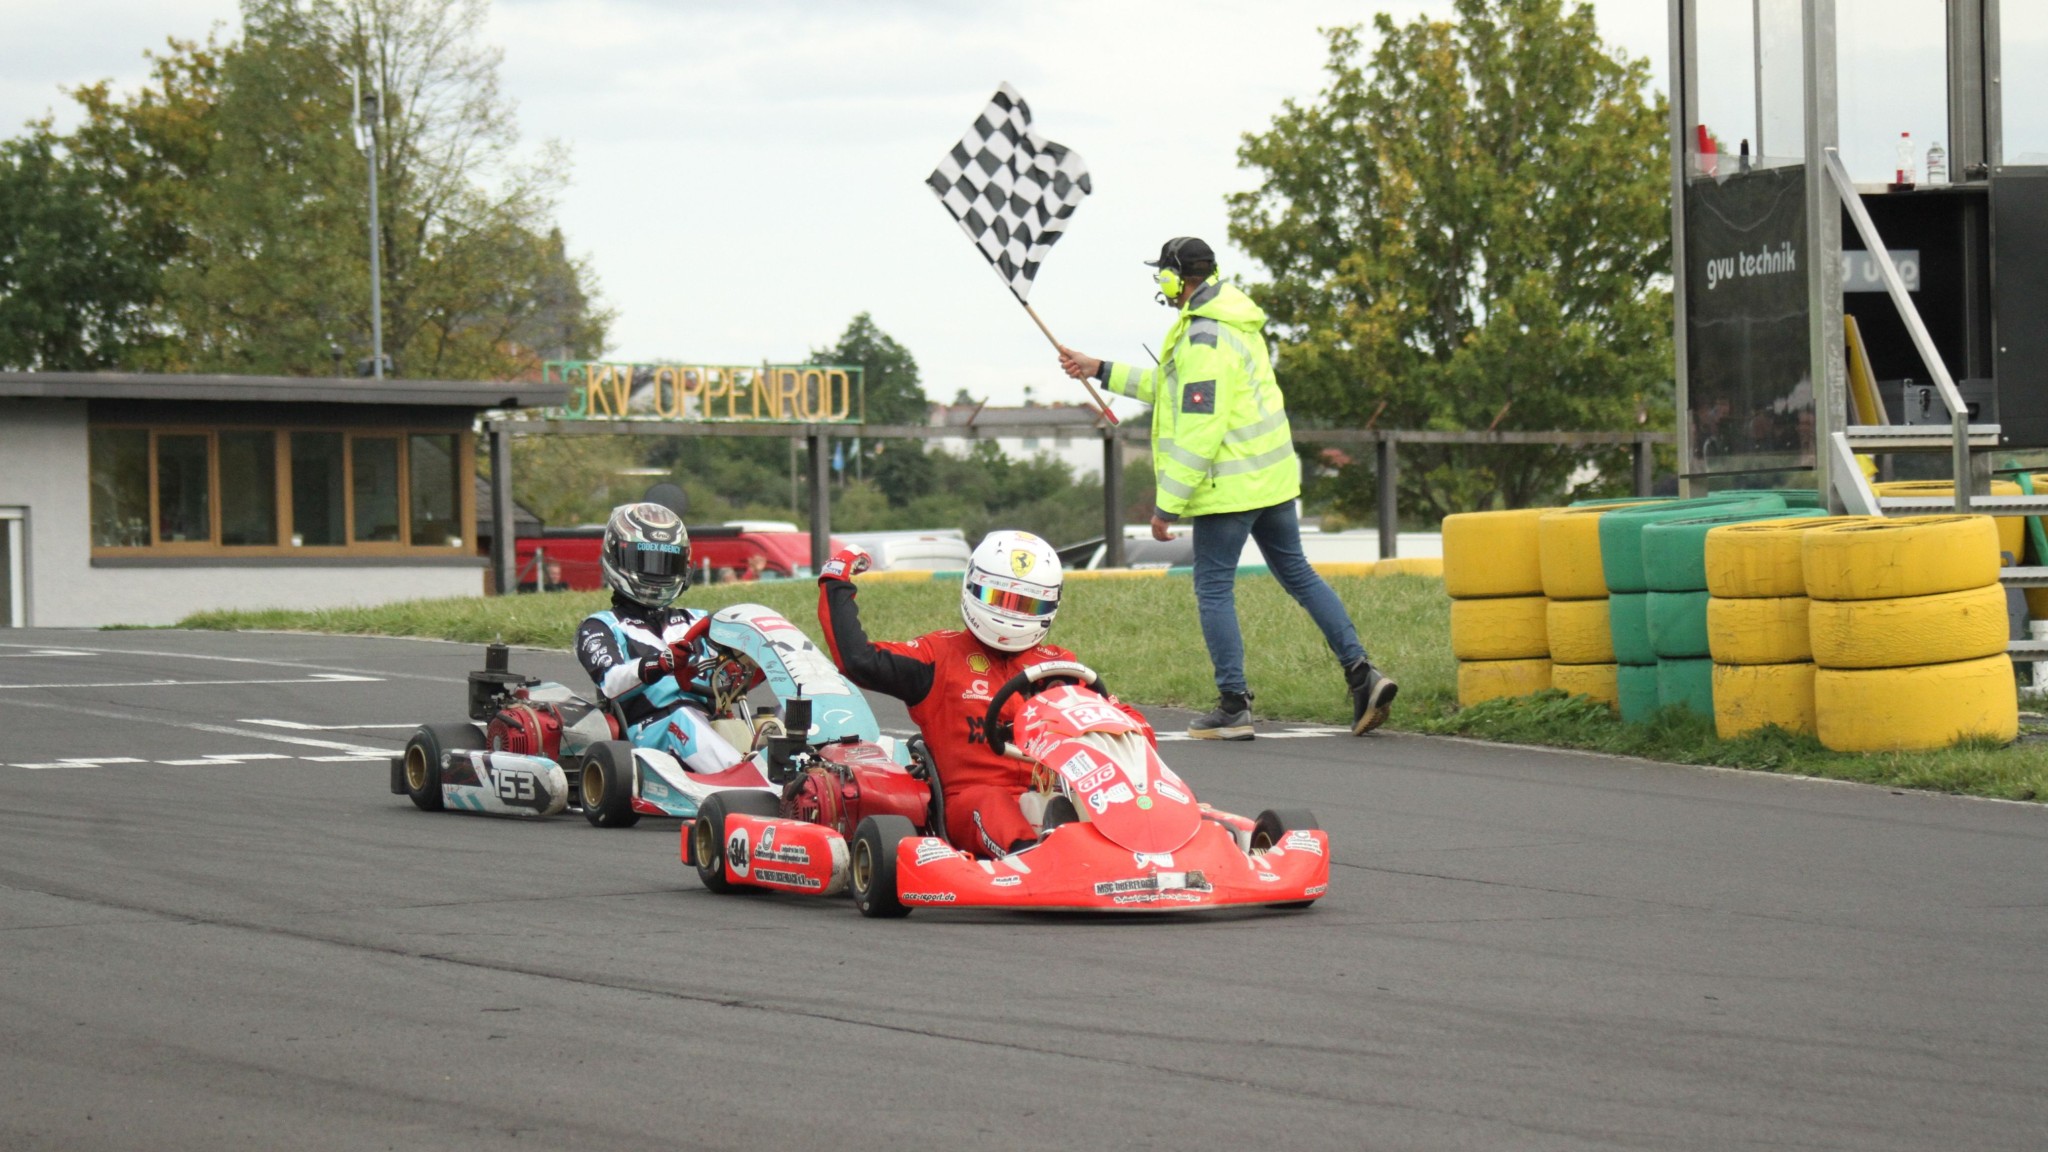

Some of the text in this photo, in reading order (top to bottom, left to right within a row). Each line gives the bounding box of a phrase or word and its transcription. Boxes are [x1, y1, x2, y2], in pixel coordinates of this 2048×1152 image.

[1707, 241, 1796, 290] gvu technik
[655, 366, 850, 420] OPPENROD
[637, 543, 681, 554] CODEX AGENCY
[1075, 707, 1125, 724] 34
[491, 767, 536, 801] 153
[730, 838, 747, 869] 34
[903, 892, 955, 902] race-report.de
[1096, 882, 1114, 894] MSC
